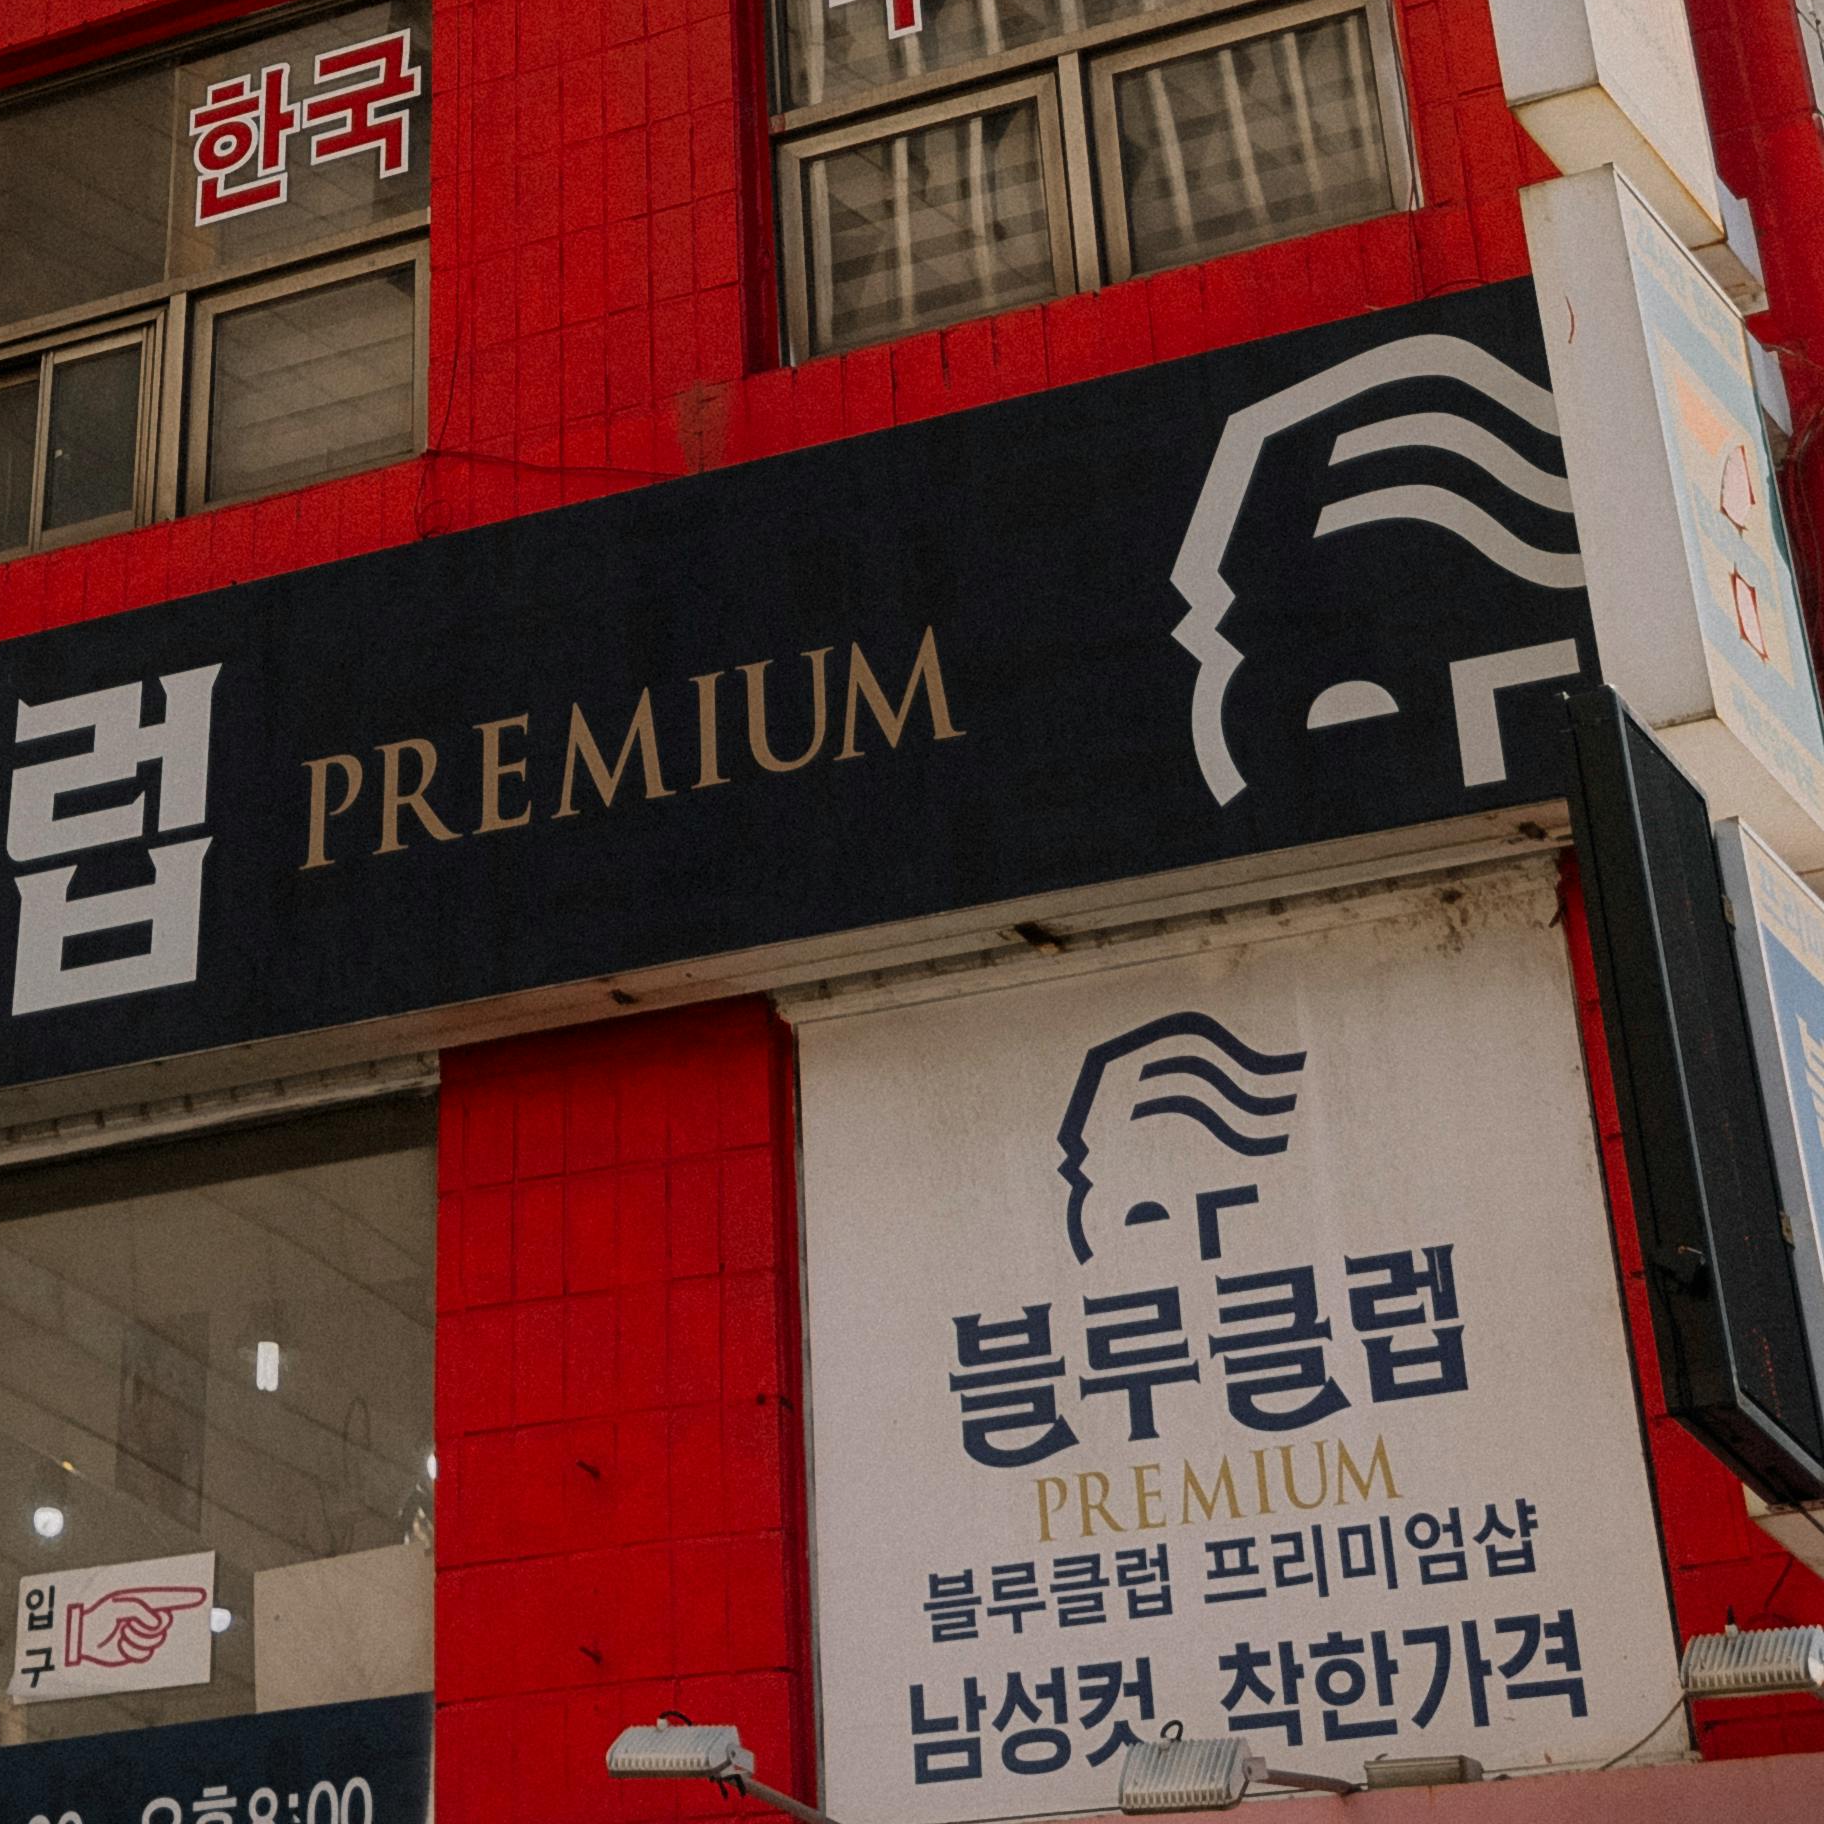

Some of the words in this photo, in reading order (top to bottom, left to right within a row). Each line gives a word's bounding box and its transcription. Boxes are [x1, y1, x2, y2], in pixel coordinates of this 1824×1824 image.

[188, 27, 422, 227] 한국
[298, 625, 966, 872] PREMIUM
[948, 1244, 1469, 1468] 블루클럽
[923, 1542, 1175, 1644] 블루클럽
[1202, 1497, 1539, 1605] 프리미엄샵
[1032, 1434, 1404, 1543] PREMIUM
[20, 1585, 56, 1689] 입구
[909, 1656, 1161, 1786] 남성컷
[1218, 1607, 1588, 1748] 착한가격
